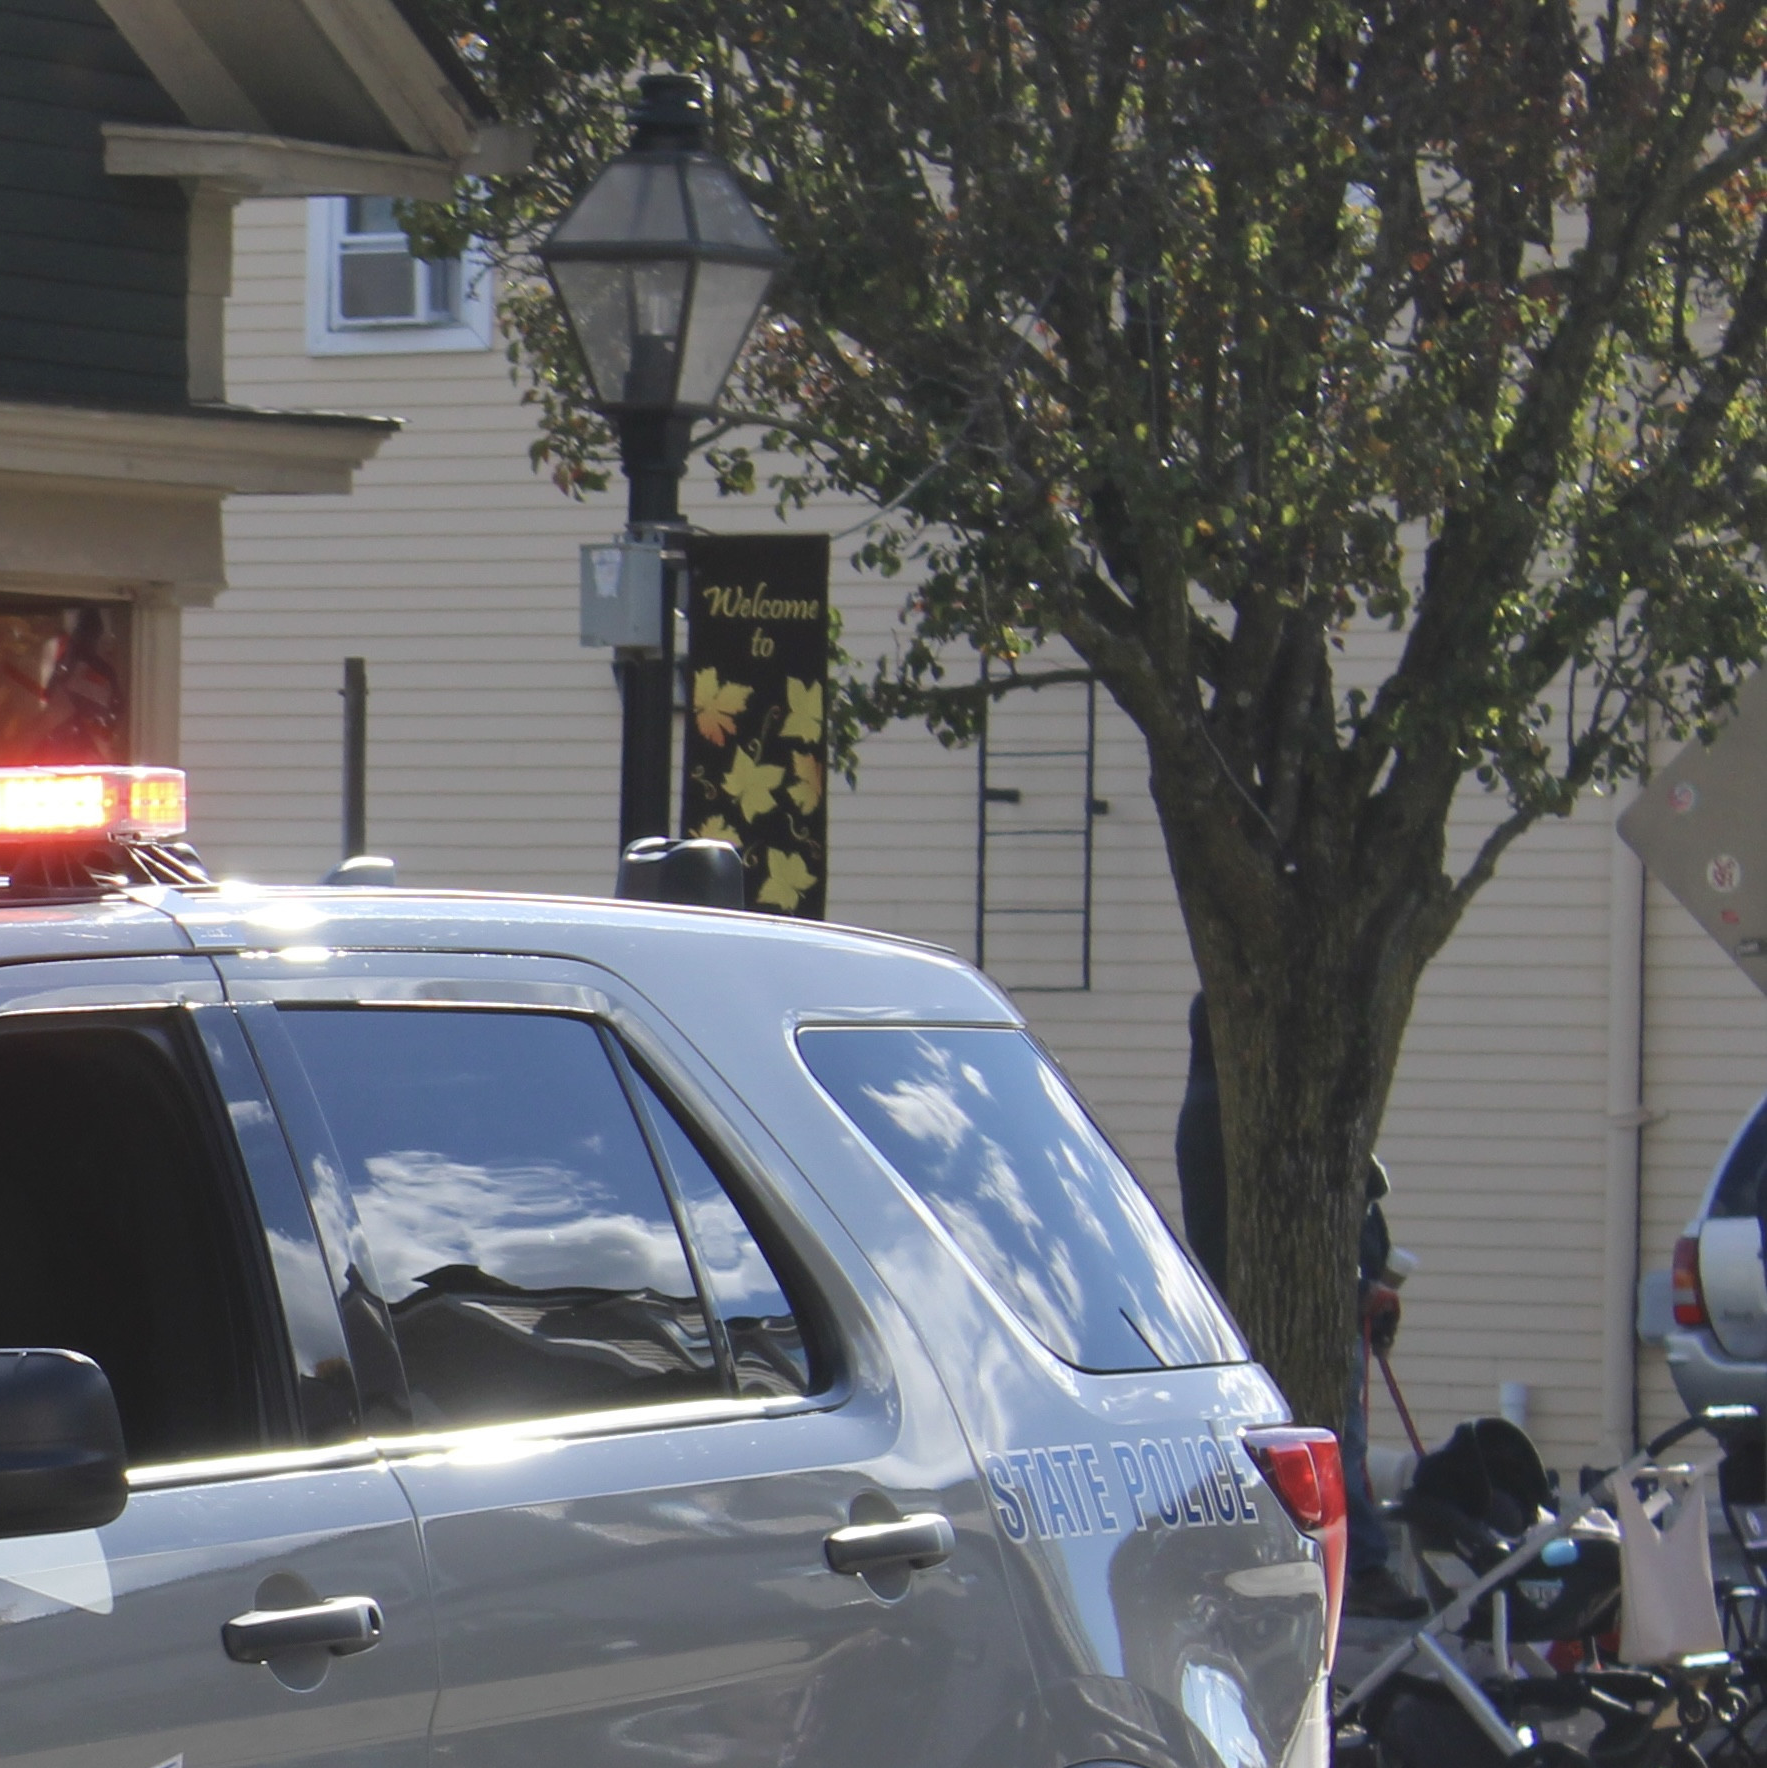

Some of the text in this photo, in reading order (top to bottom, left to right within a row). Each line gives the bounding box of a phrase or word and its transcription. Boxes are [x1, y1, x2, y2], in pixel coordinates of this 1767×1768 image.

[703, 581, 819, 621] Welcome
[751, 626, 774, 657] to
[983, 1433, 1261, 1545] STATE POLICE
